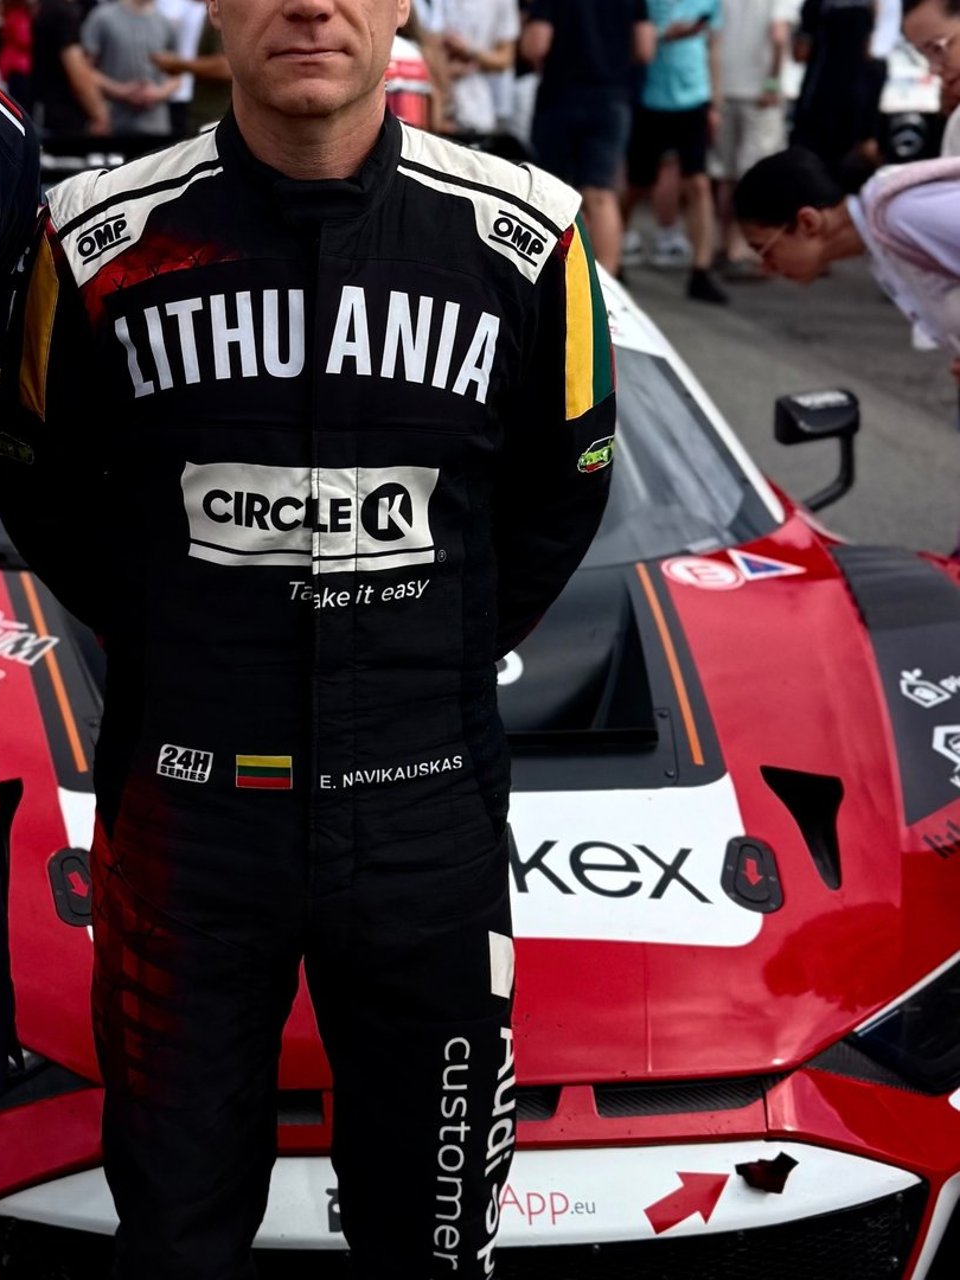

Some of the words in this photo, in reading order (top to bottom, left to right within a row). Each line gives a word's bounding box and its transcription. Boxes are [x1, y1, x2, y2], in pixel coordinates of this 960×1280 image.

[77, 219, 127, 257] OMP
[493, 217, 544, 257] OMP
[202, 489, 353, 533] CIRCLE
[355, 584, 374, 605] it
[381, 579, 429, 602] easy
[160, 765, 207, 782] SERIES
[161, 746, 211, 773] 24H
[320, 775, 337, 789] E.
[343, 755, 463, 788] NAVIKAUSKAS
[433, 1037, 471, 1270] customer
